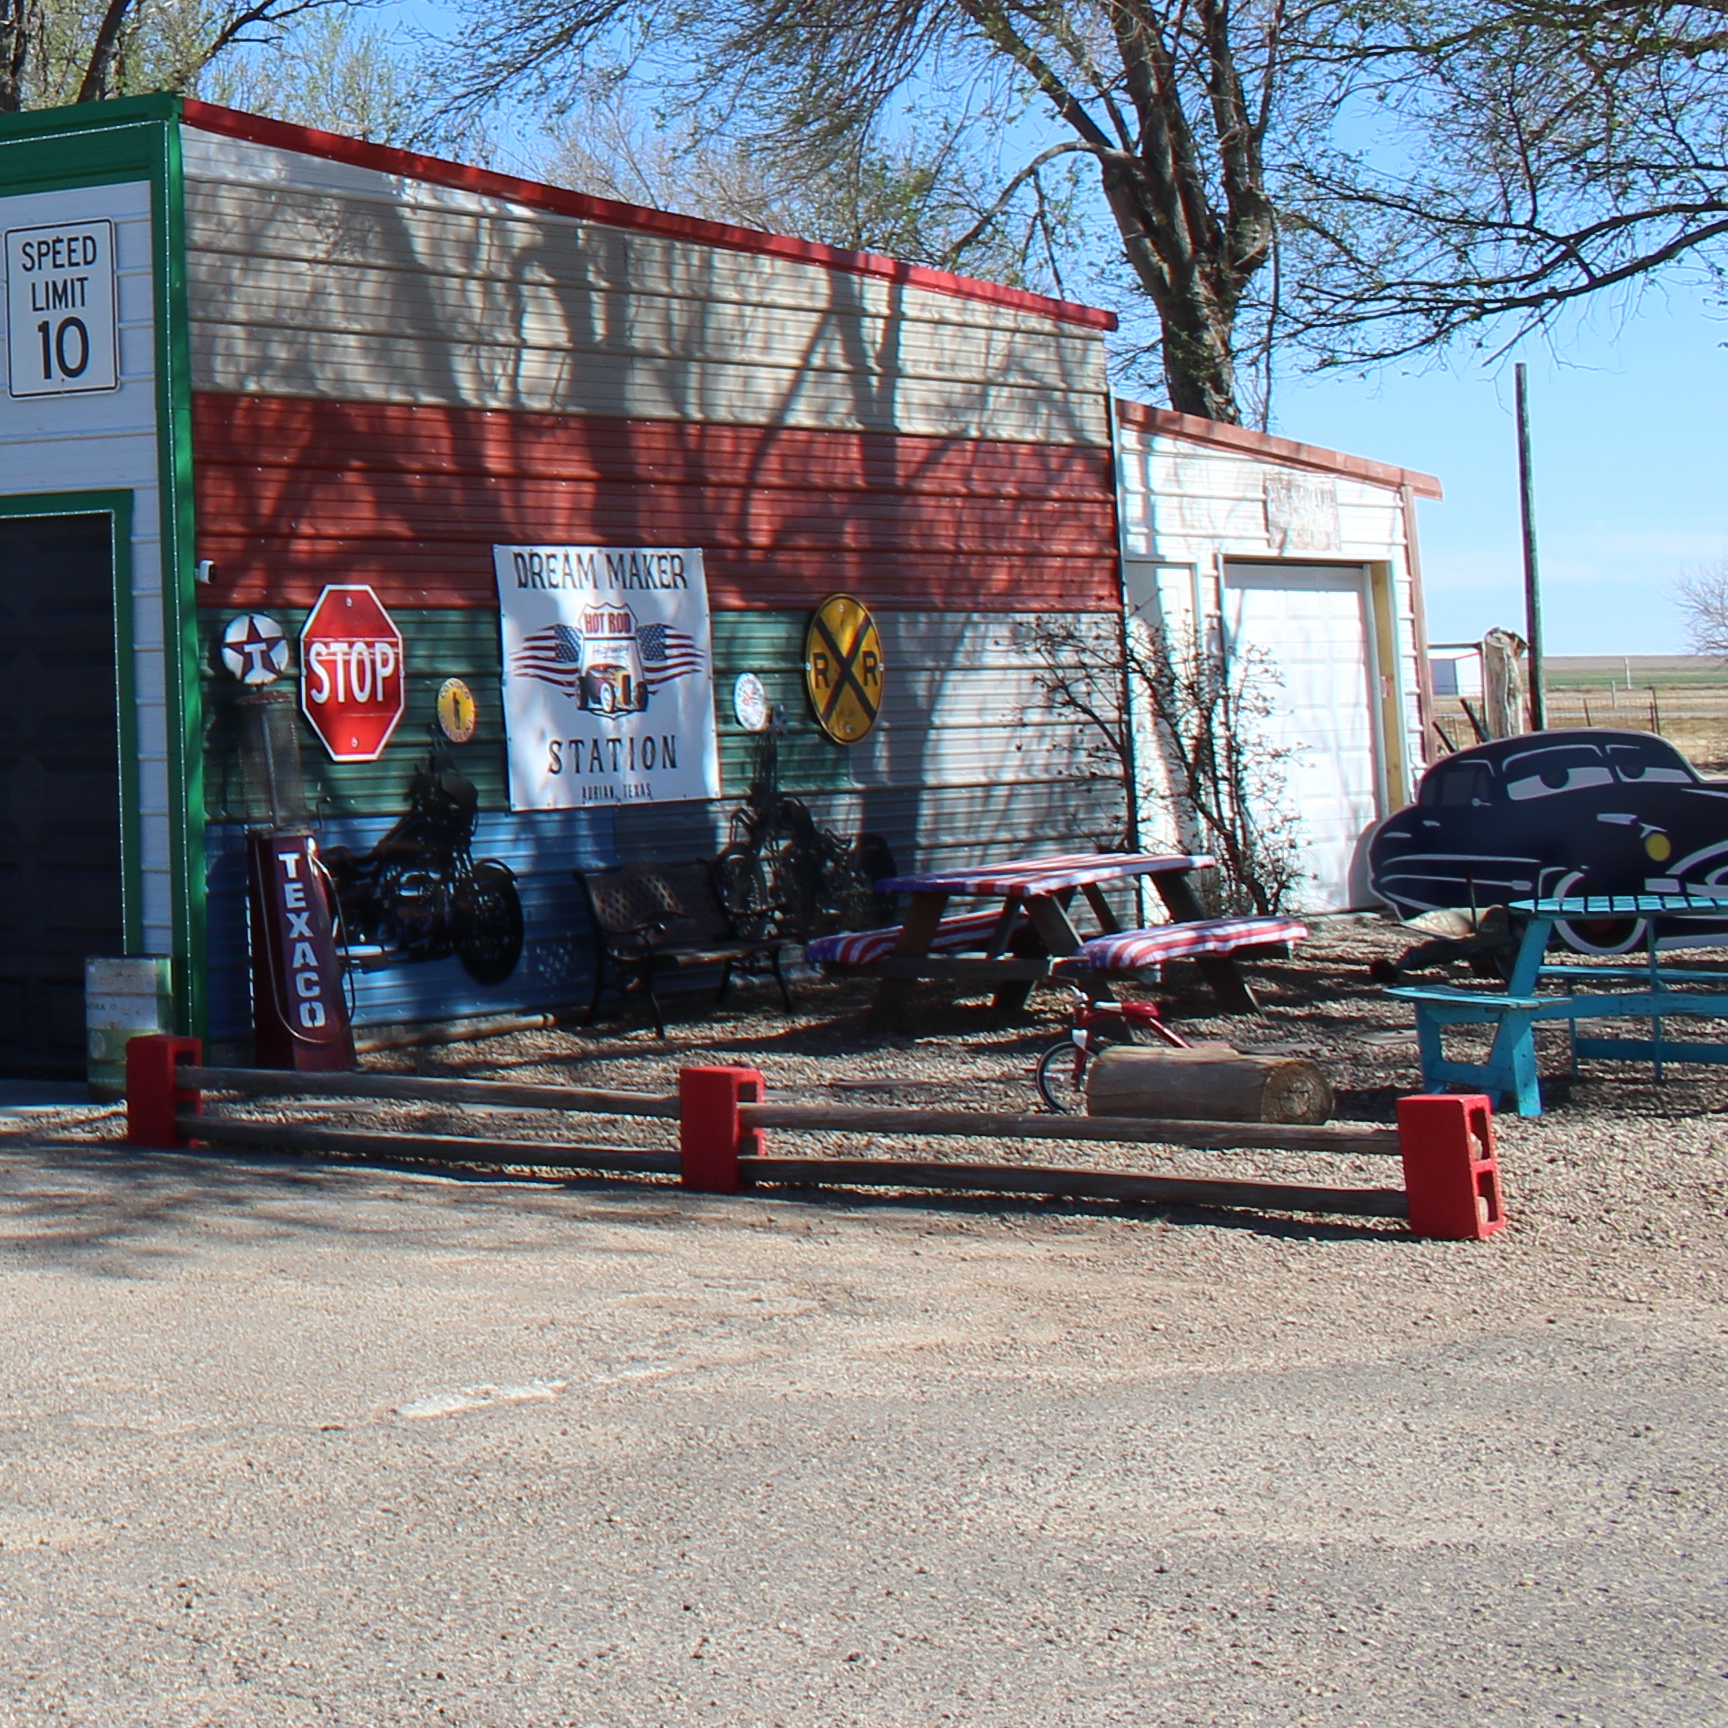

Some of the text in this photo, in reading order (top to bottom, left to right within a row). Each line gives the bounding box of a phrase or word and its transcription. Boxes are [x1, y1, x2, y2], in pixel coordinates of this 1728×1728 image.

[21, 236, 97, 272] SPEED
[31, 277, 88, 312] LIMIT
[38, 316, 89, 380] 10
[512, 551, 688, 590] DREAM MAKER
[584, 611, 631, 634] HOT ROD
[310, 640, 395, 704] STOP
[813, 650, 879, 689] R R
[548, 734, 678, 775] STATION
[622, 783, 652, 800] TEXAS
[277, 851, 327, 1029] TEXACO
